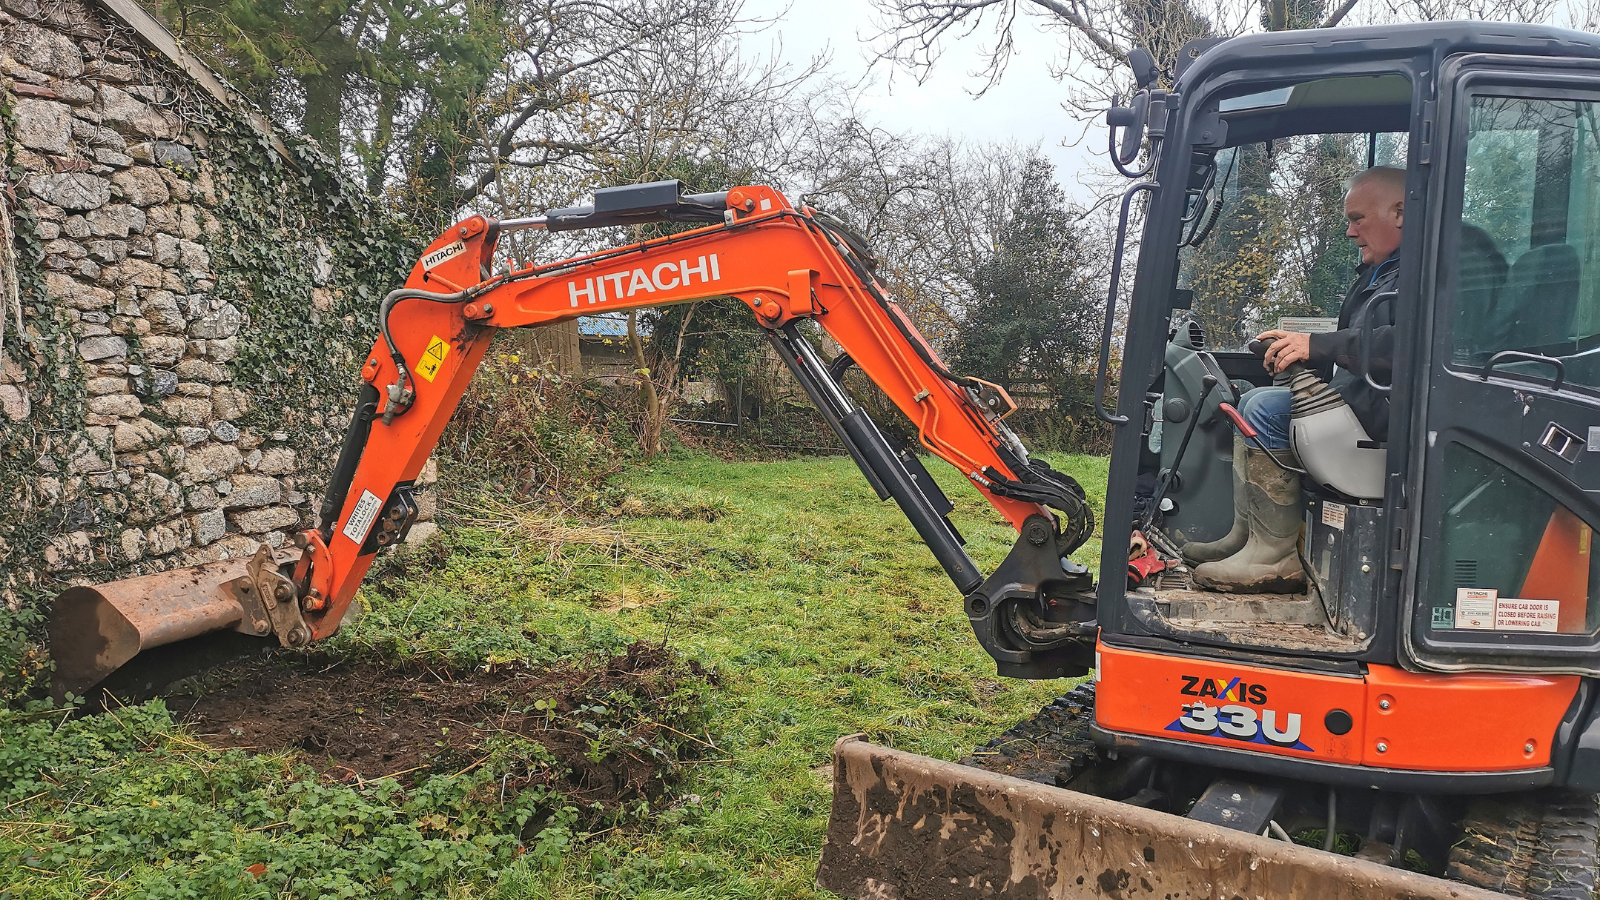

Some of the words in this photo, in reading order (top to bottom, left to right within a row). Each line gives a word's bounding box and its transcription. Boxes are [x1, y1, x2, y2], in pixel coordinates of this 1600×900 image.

[425, 242, 463, 266] HITACHI
[568, 253, 721, 308] HITACHI
[349, 499, 366, 525] WHITES
[350, 501, 372, 536] TOTALOCK
[1180, 675, 1268, 705] ZAXIS
[1179, 702, 1302, 747] 33U
